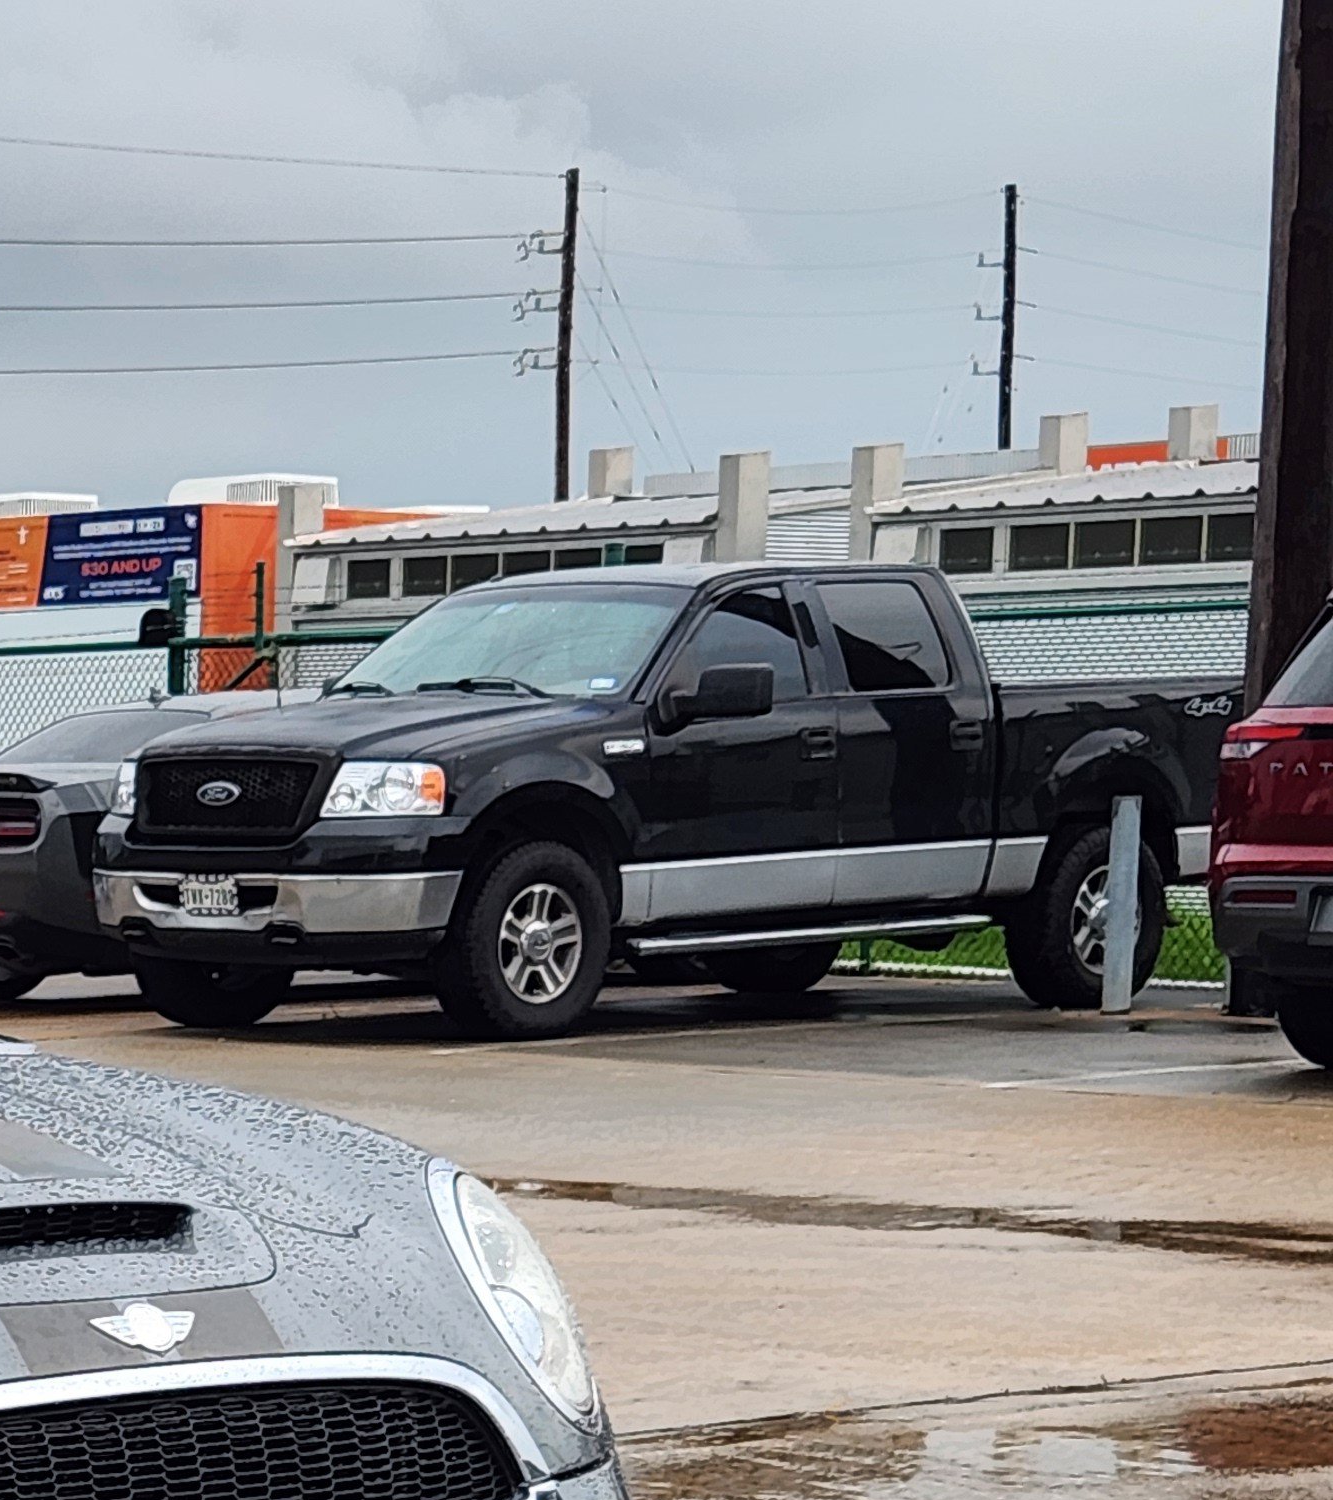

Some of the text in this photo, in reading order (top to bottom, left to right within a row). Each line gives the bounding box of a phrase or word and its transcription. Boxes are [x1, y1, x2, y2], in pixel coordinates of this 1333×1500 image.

[81, 557, 162, 576] $30 AND UP
